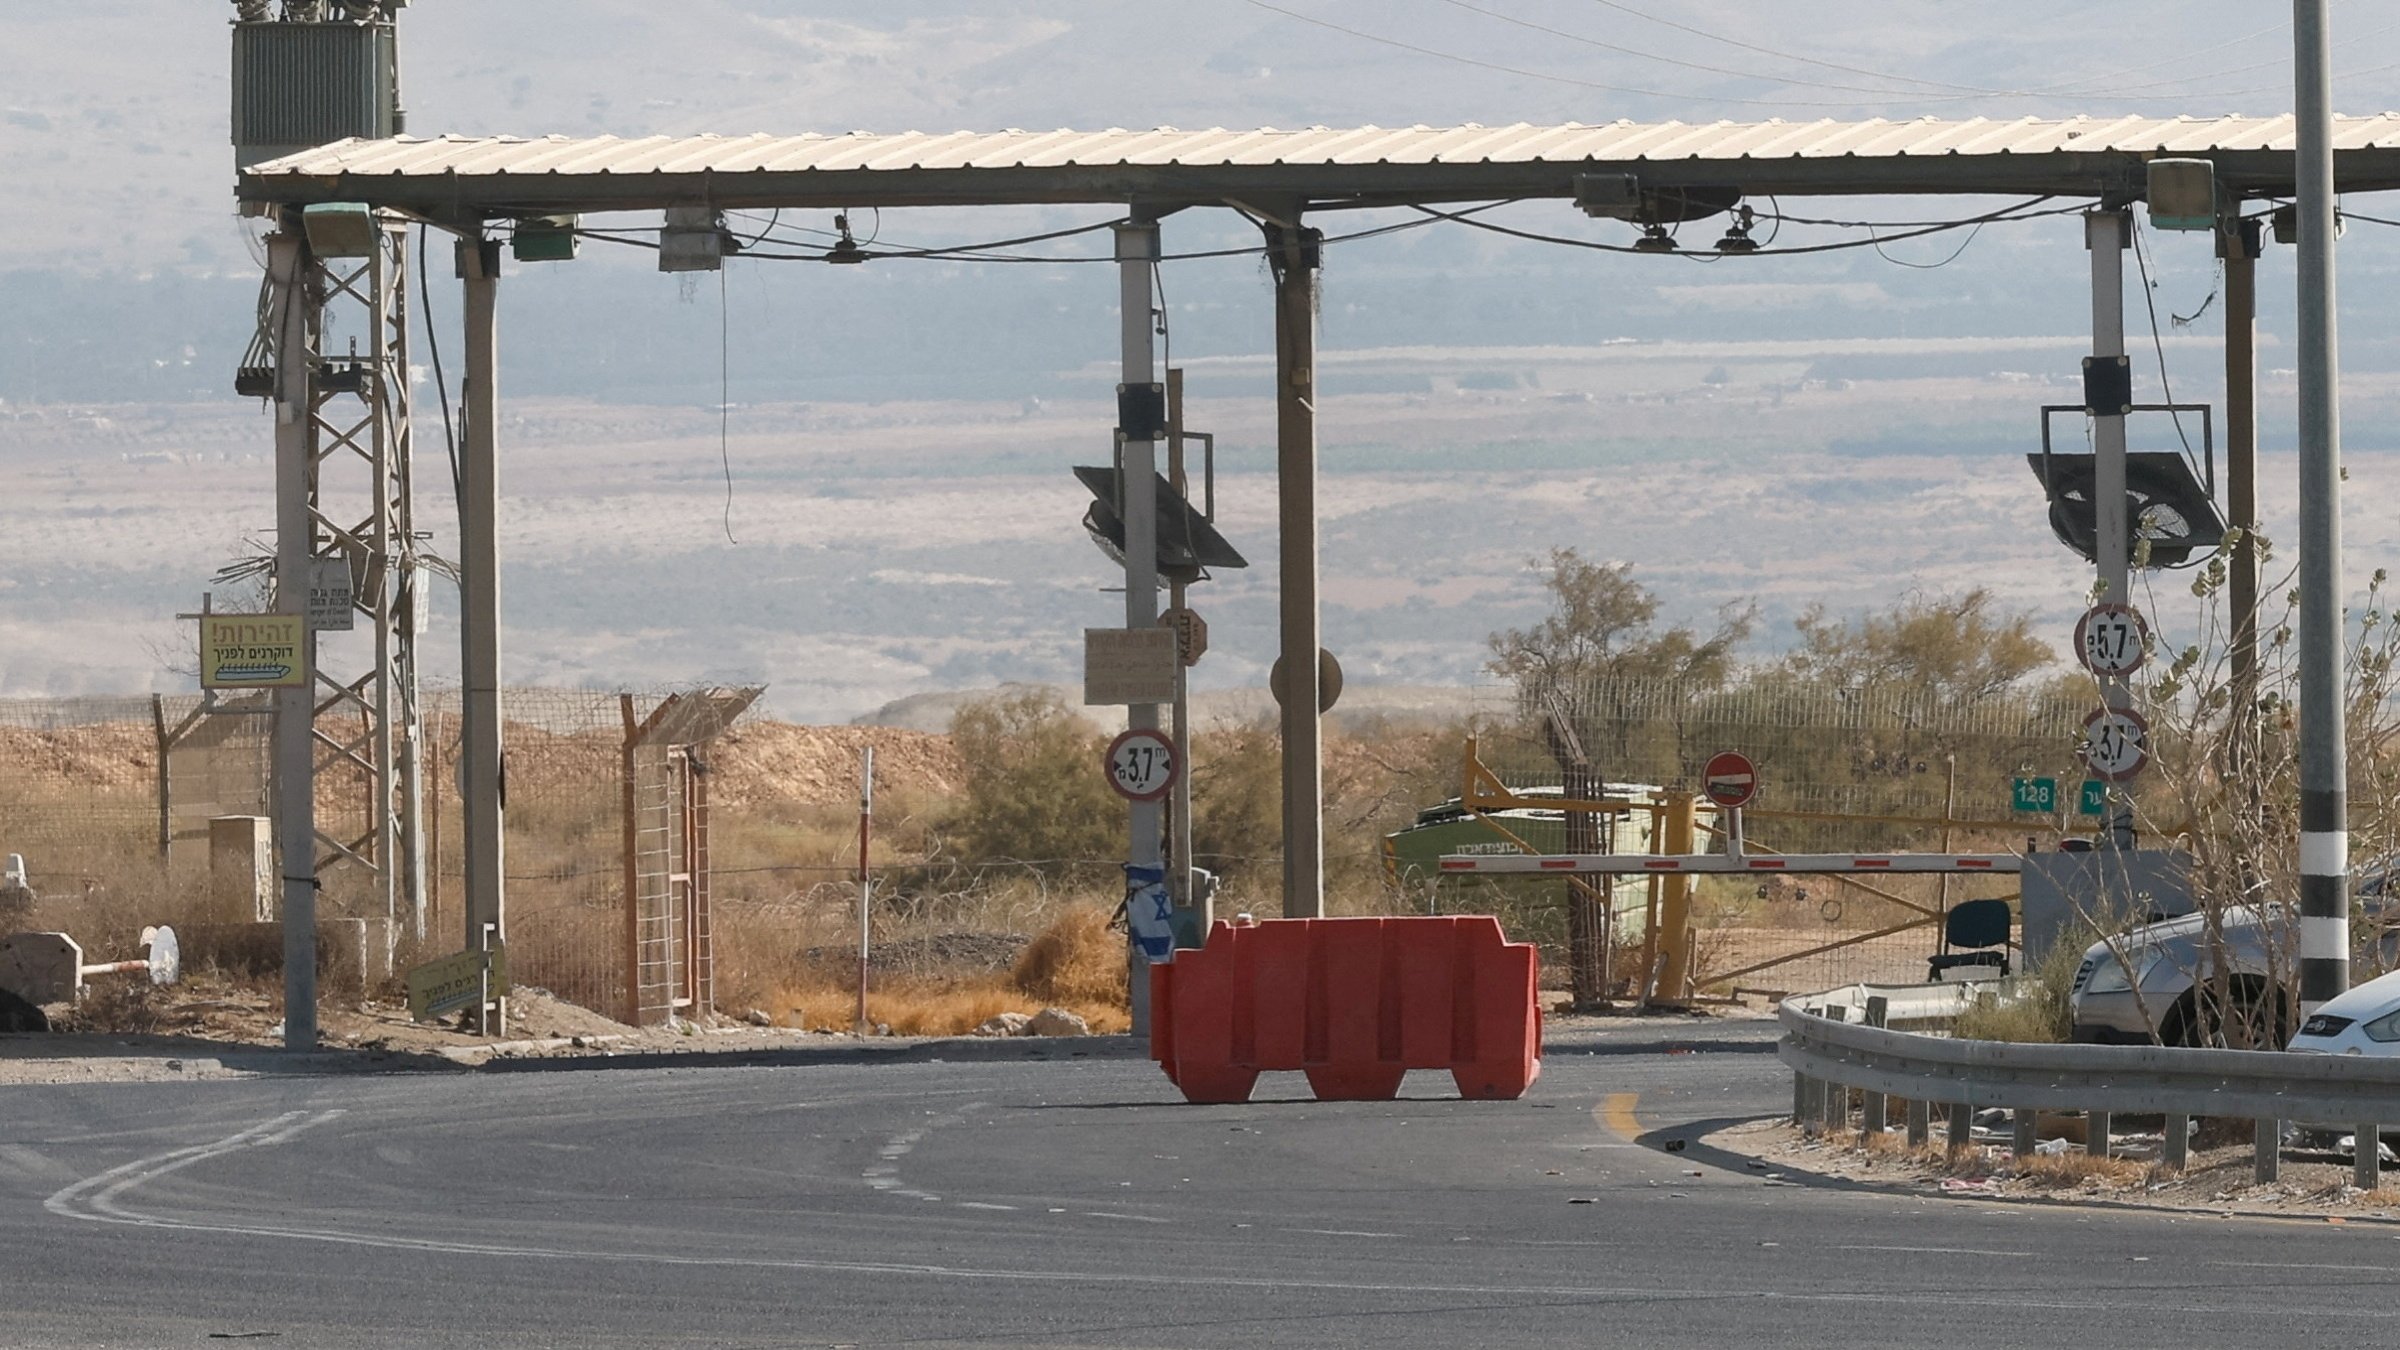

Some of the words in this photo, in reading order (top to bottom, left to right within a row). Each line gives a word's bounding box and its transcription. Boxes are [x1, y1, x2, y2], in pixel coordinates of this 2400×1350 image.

[213, 623, 293, 643] זהירות!
[2097, 624, 2127, 660] 5.7
[213, 645, 245, 663] לפניך
[249, 647, 294, 662] דוקרנים
[2100, 724, 2126, 761] 3.7
[1127, 747, 1153, 783] 3.7
[2017, 786, 2048, 803] 128
